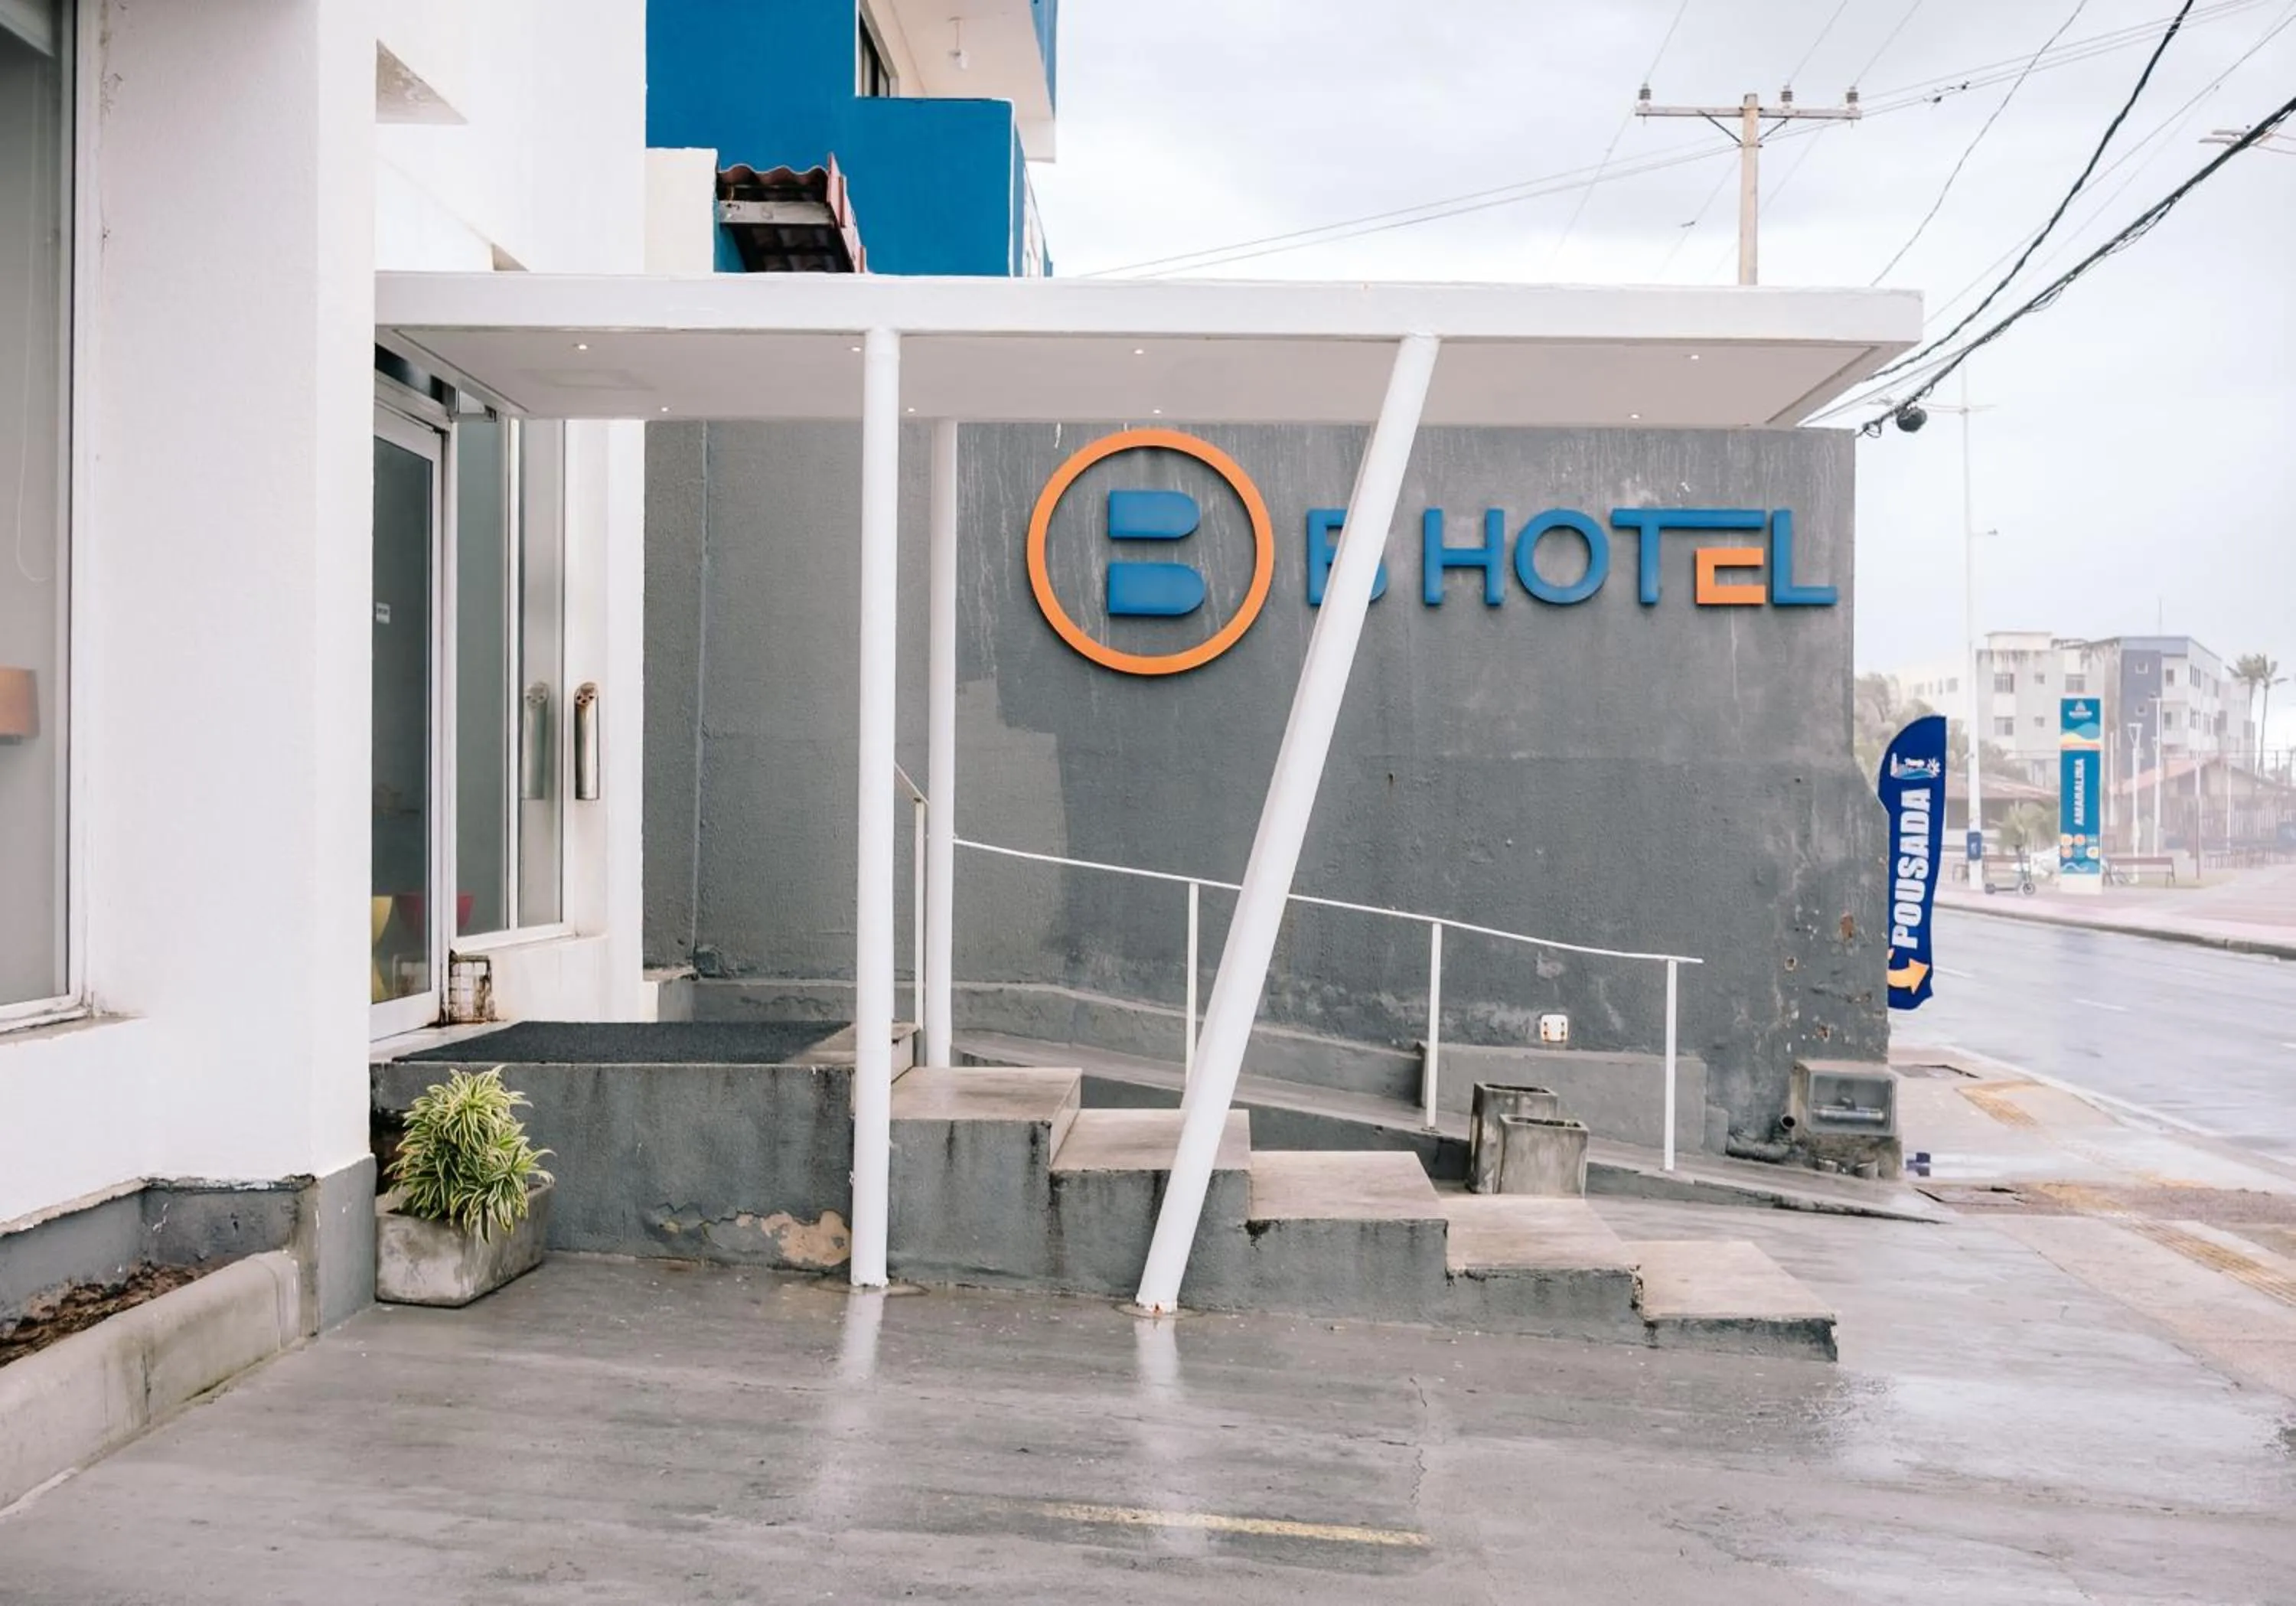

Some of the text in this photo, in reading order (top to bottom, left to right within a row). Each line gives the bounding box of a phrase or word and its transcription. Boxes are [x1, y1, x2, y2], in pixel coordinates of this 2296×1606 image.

[1108, 490, 1205, 615] B
[1422, 508, 1838, 606] HOTEL
[1892, 788, 1932, 949] POUSADA
